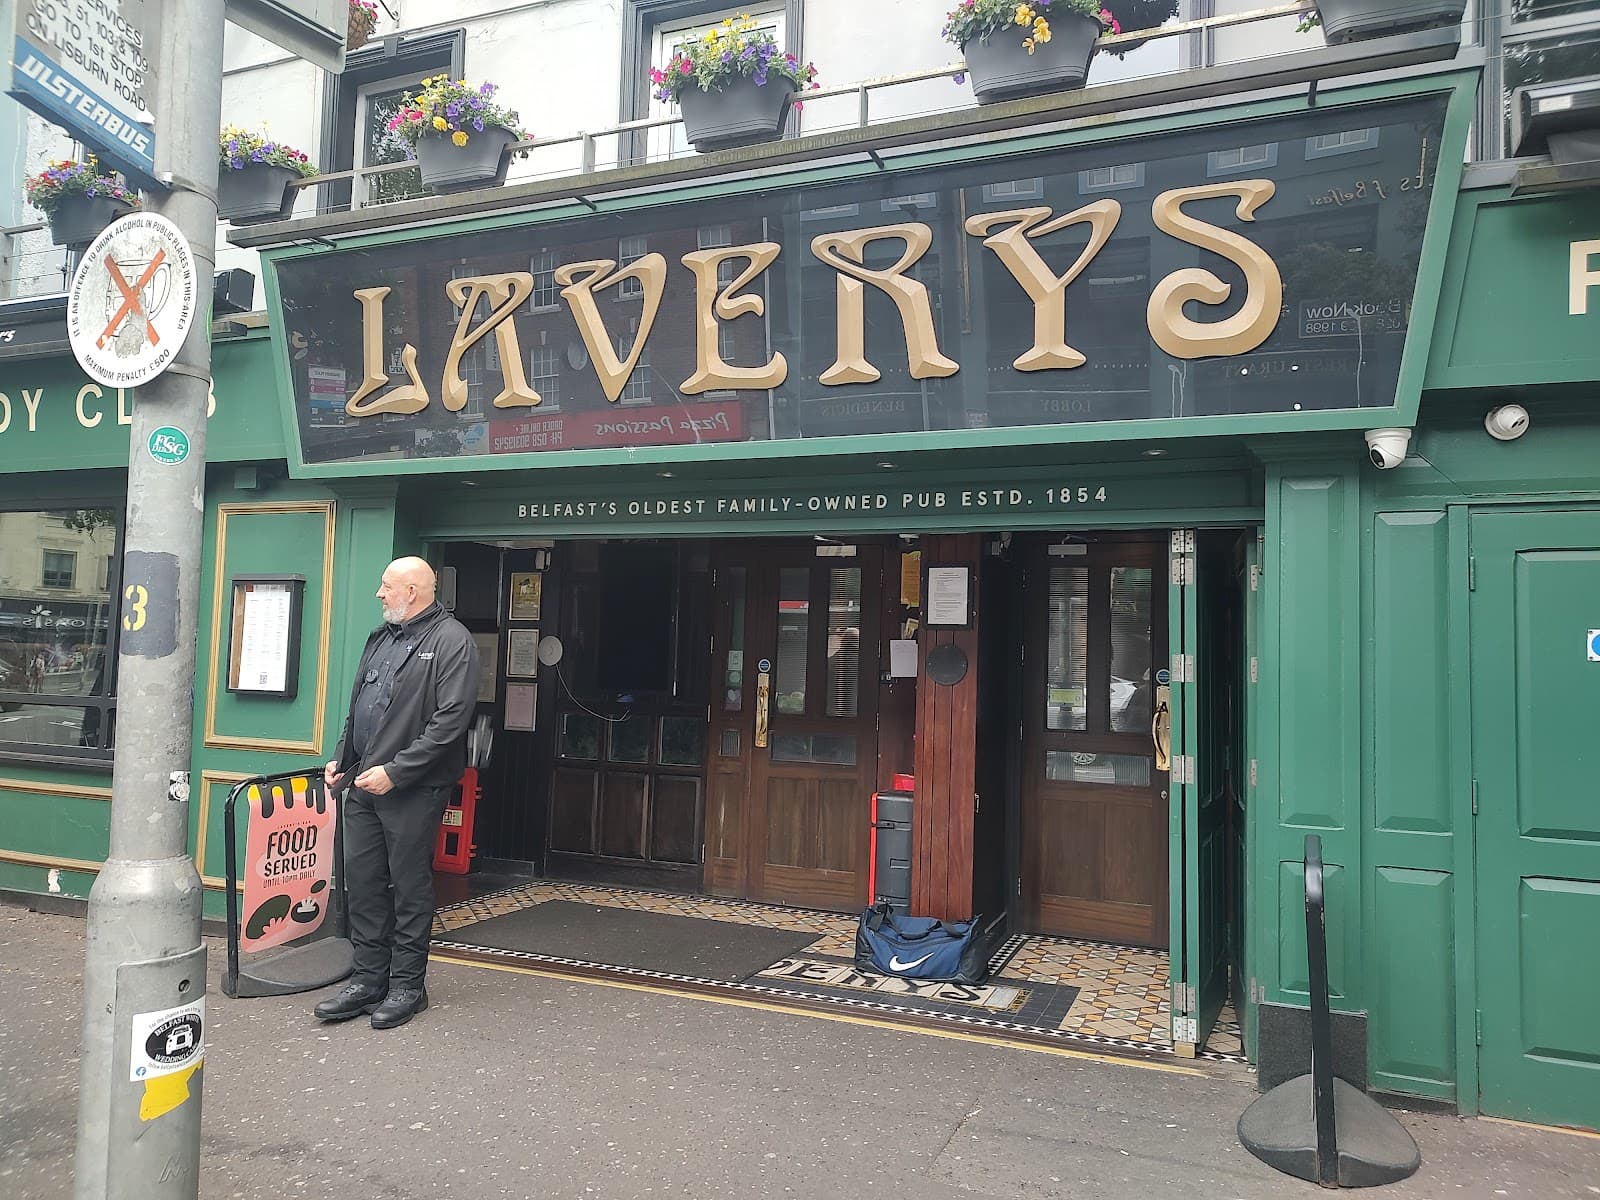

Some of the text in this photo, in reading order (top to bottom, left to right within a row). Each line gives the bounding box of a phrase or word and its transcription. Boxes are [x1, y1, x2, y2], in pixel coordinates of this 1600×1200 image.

[26, 13, 146, 112] ON LISBURN ROAD
[64, 16, 81, 41] TO
[88, 37, 105, 61] 1st
[111, 56, 143, 86] STOP
[96, 21, 114, 46] 103
[132, 48, 149, 73] 109
[21, 55, 149, 153] ULSTERBUS
[73, 264, 90, 301] OFFENCE
[95, 230, 115, 254] DRINK
[115, 218, 144, 237] ALCOHOL
[152, 221, 175, 242] PUBLIC
[172, 238, 189, 269] PLACES
[345, 179, 1283, 417] LAVERYS
[84, 348, 171, 382] MAXIMUM PENALTY £500
[518, 486, 1107, 518] BELFAST'S OLDEST FAMILY-OWNED PUB ESTD. 1854
[123, 585, 148, 632] 3
[266, 824, 318, 860] FOOD
[299, 869, 317, 881] DAILY
[154, 1015, 186, 1037] BELFAST
[155, 1053, 187, 1063] WEDDING
